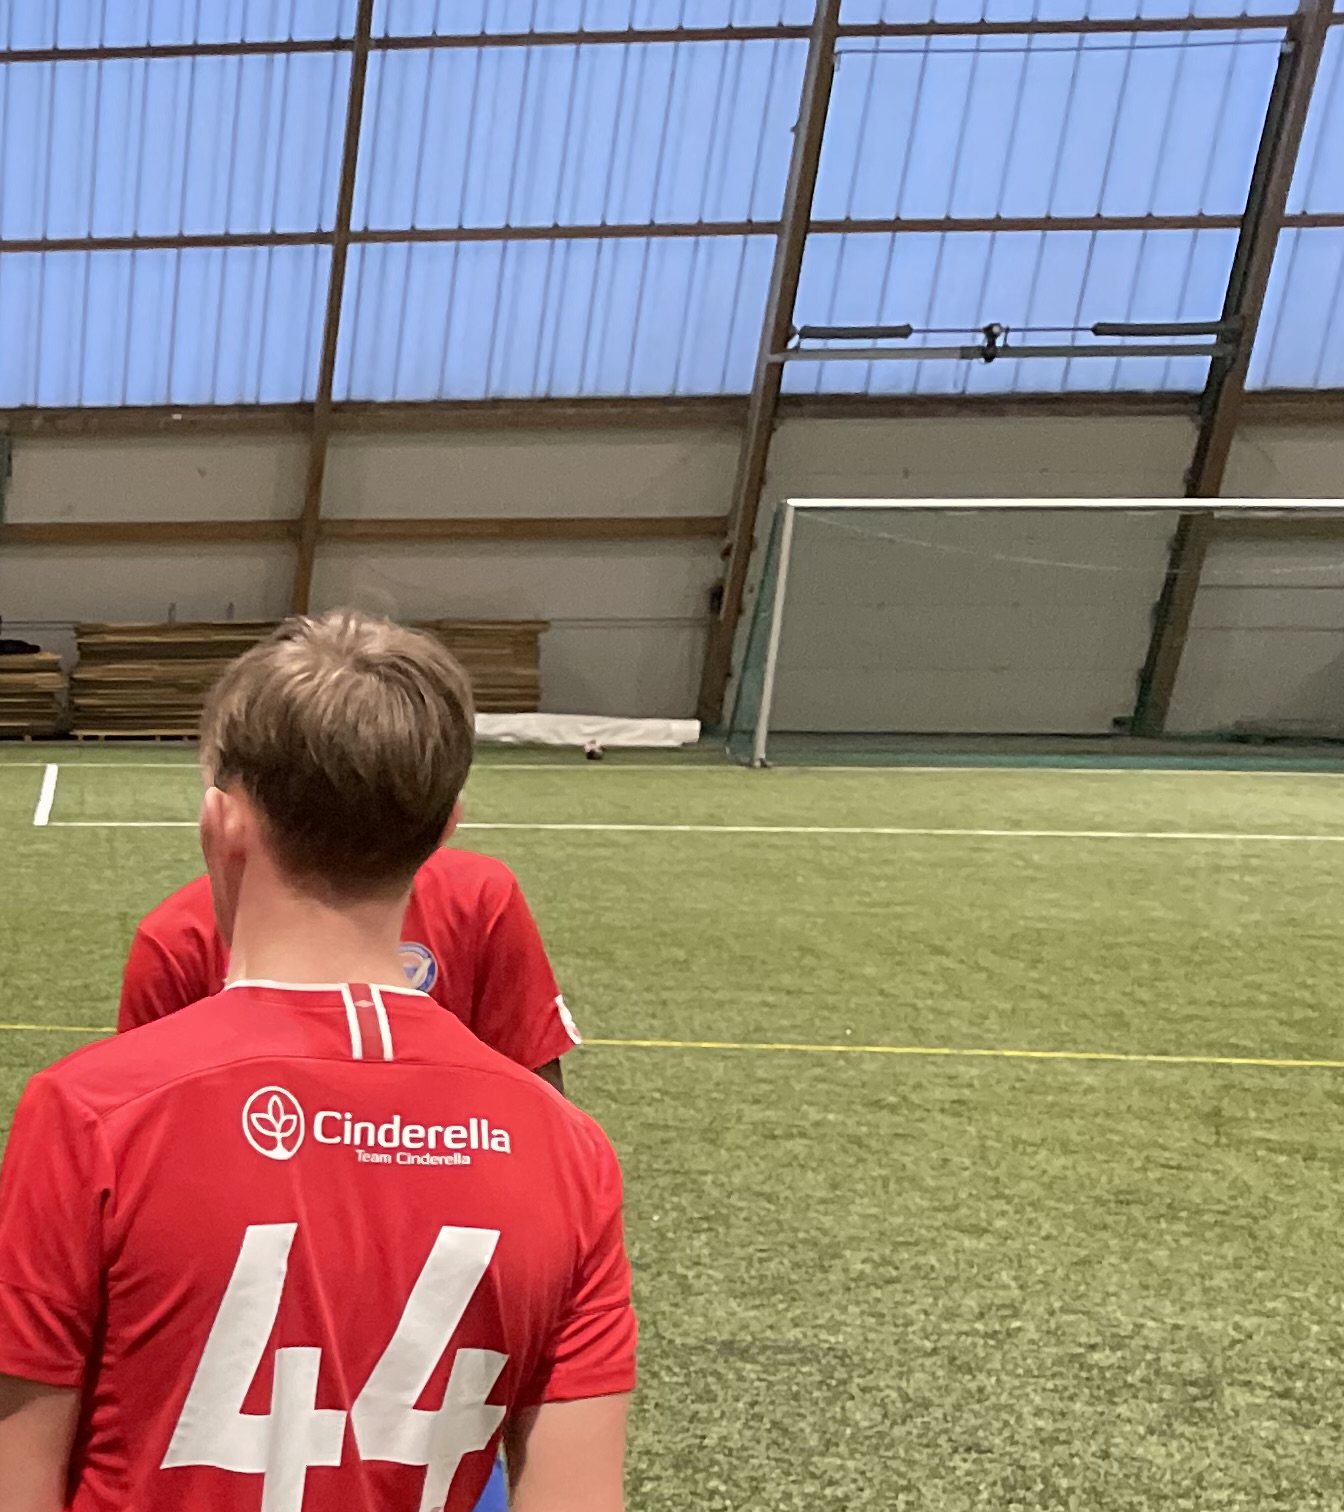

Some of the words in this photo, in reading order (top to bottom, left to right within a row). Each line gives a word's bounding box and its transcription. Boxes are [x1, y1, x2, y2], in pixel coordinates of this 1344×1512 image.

[313, 1110, 512, 1154] Cinderella
[356, 1150, 392, 1164] Team
[395, 1152, 472, 1166] Cinderella
